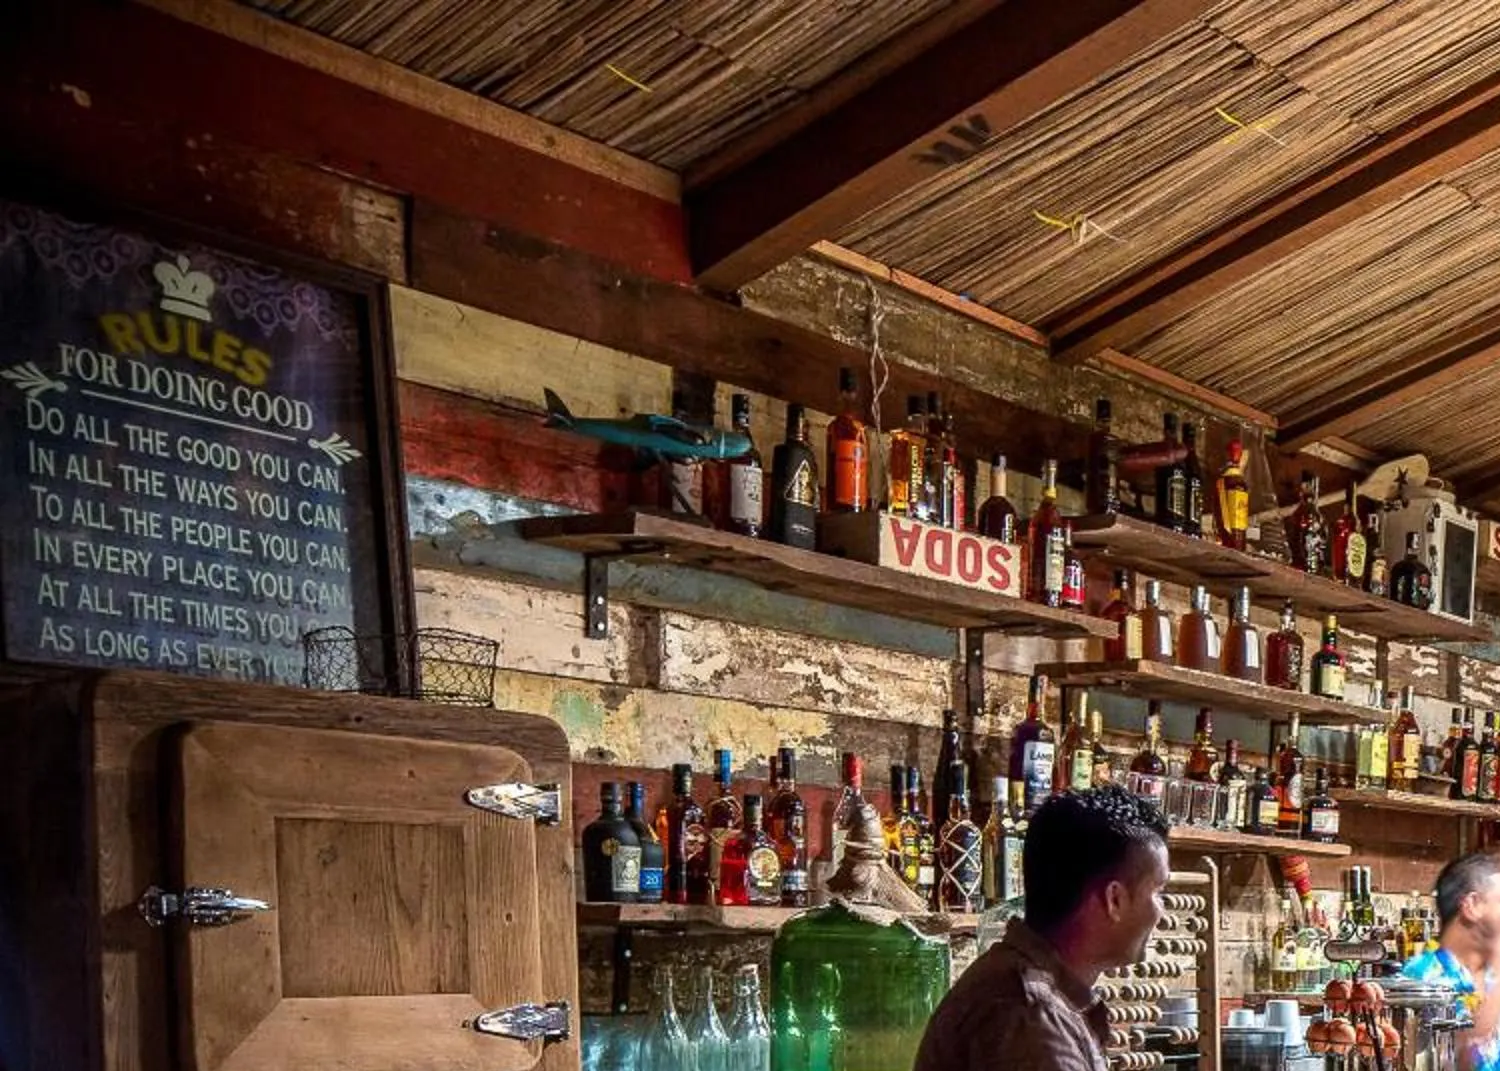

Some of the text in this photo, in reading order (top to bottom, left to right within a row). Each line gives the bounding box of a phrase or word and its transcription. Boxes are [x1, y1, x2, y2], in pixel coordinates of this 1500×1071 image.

[100, 312, 271, 385] RULES
[60, 344, 313, 431] FOR DOING GOOD
[26, 399, 345, 495] DO ALL THE GOOD YOU CAN.
[29, 441, 348, 533] IN ALL THE WAYS YOU CAN.
[30, 486, 350, 572] TO ALL THE PEOPLE YOU CAN.
[34, 528, 61, 563] IN
[73, 541, 152, 577] EVERY
[163, 556, 239, 591] PLACE
[248, 569, 292, 600] YOU
[890, 517, 1012, 590] SODA
[38, 574, 69, 606] AT
[78, 585, 121, 617] ALL
[128, 591, 174, 623] THE
[183, 600, 249, 634] TIMES
[257, 611, 298, 641] YOU
[40, 617, 75, 652] AS
[85, 629, 149, 660] LONG
[159, 643, 187, 666] AS
[197, 645, 253, 672] EVER
